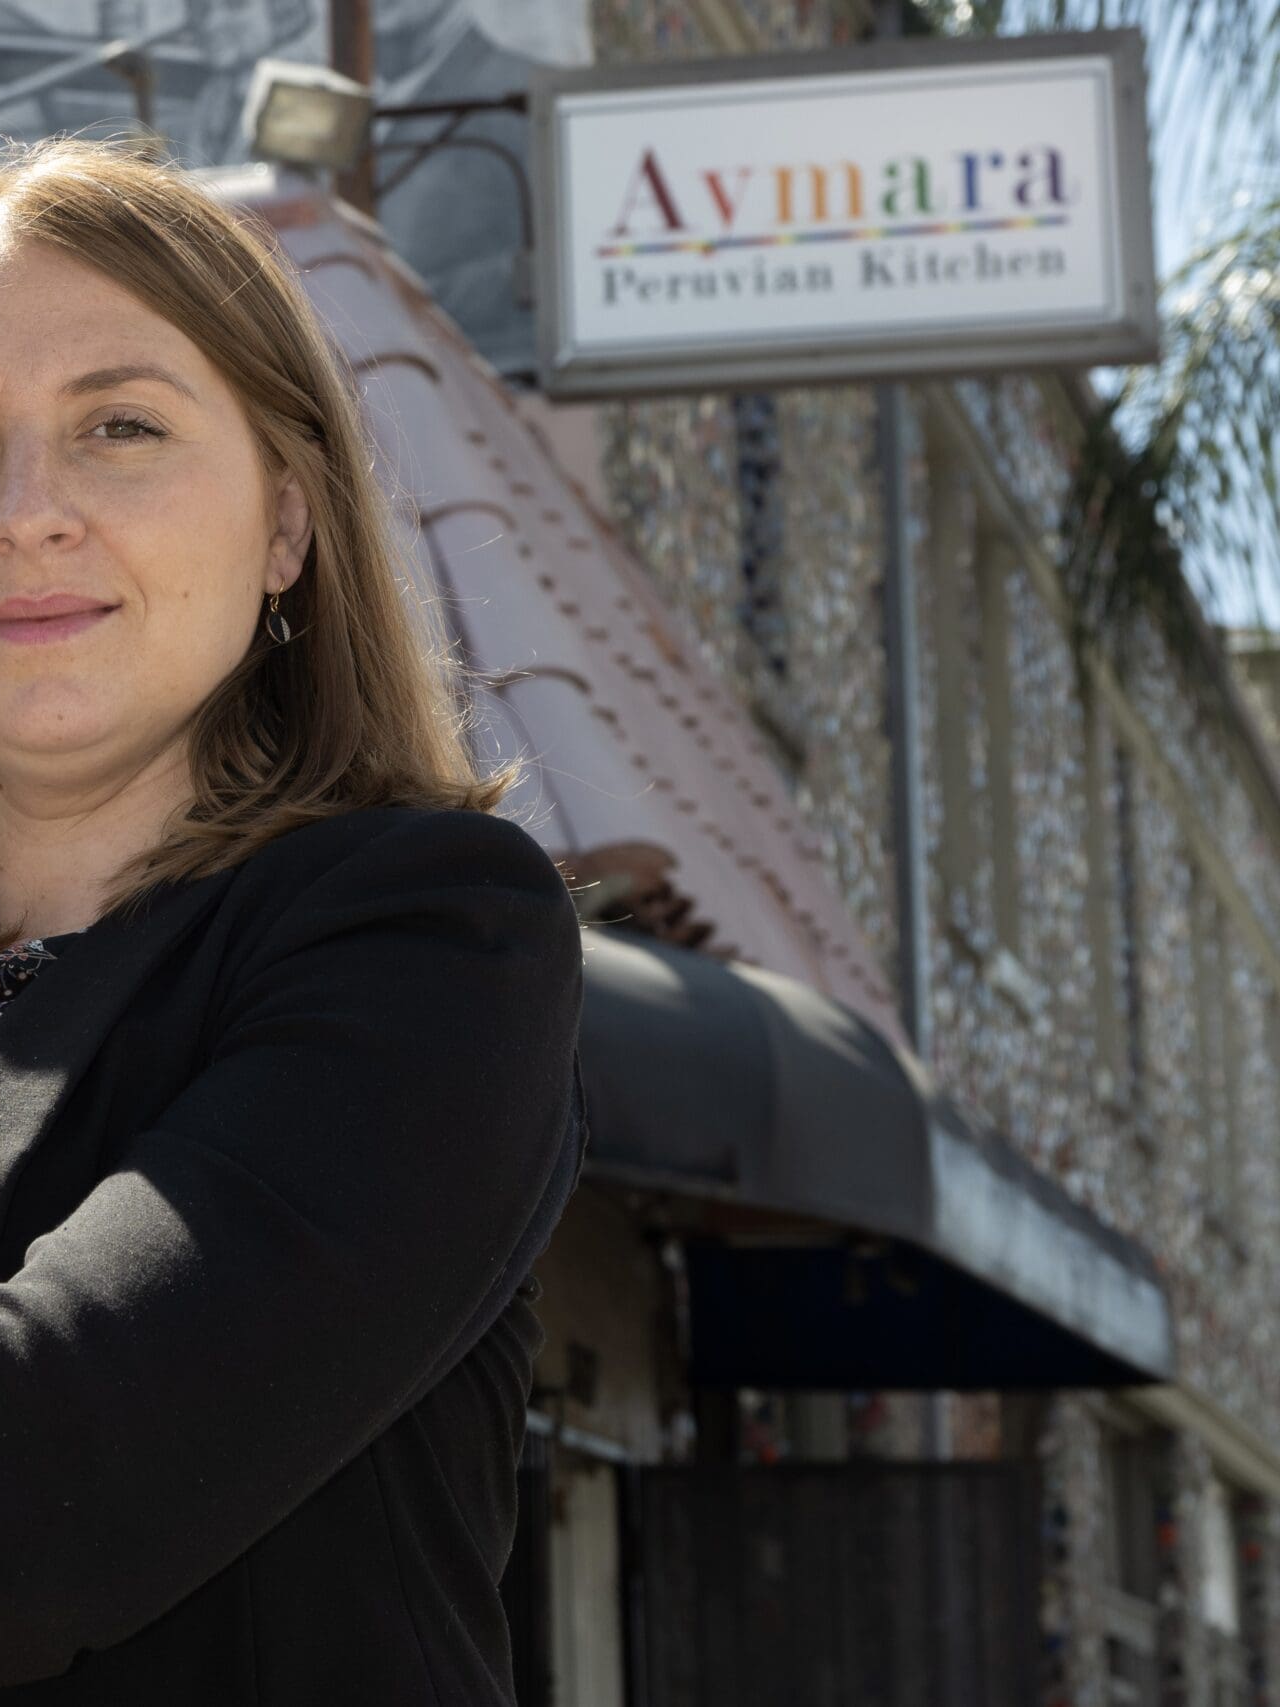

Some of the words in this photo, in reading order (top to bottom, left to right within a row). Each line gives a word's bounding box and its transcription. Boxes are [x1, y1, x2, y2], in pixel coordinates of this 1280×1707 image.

[611, 145, 1071, 257] Aymara
[602, 256, 834, 303] Peruvian
[859, 244, 1067, 290] Kitchen
